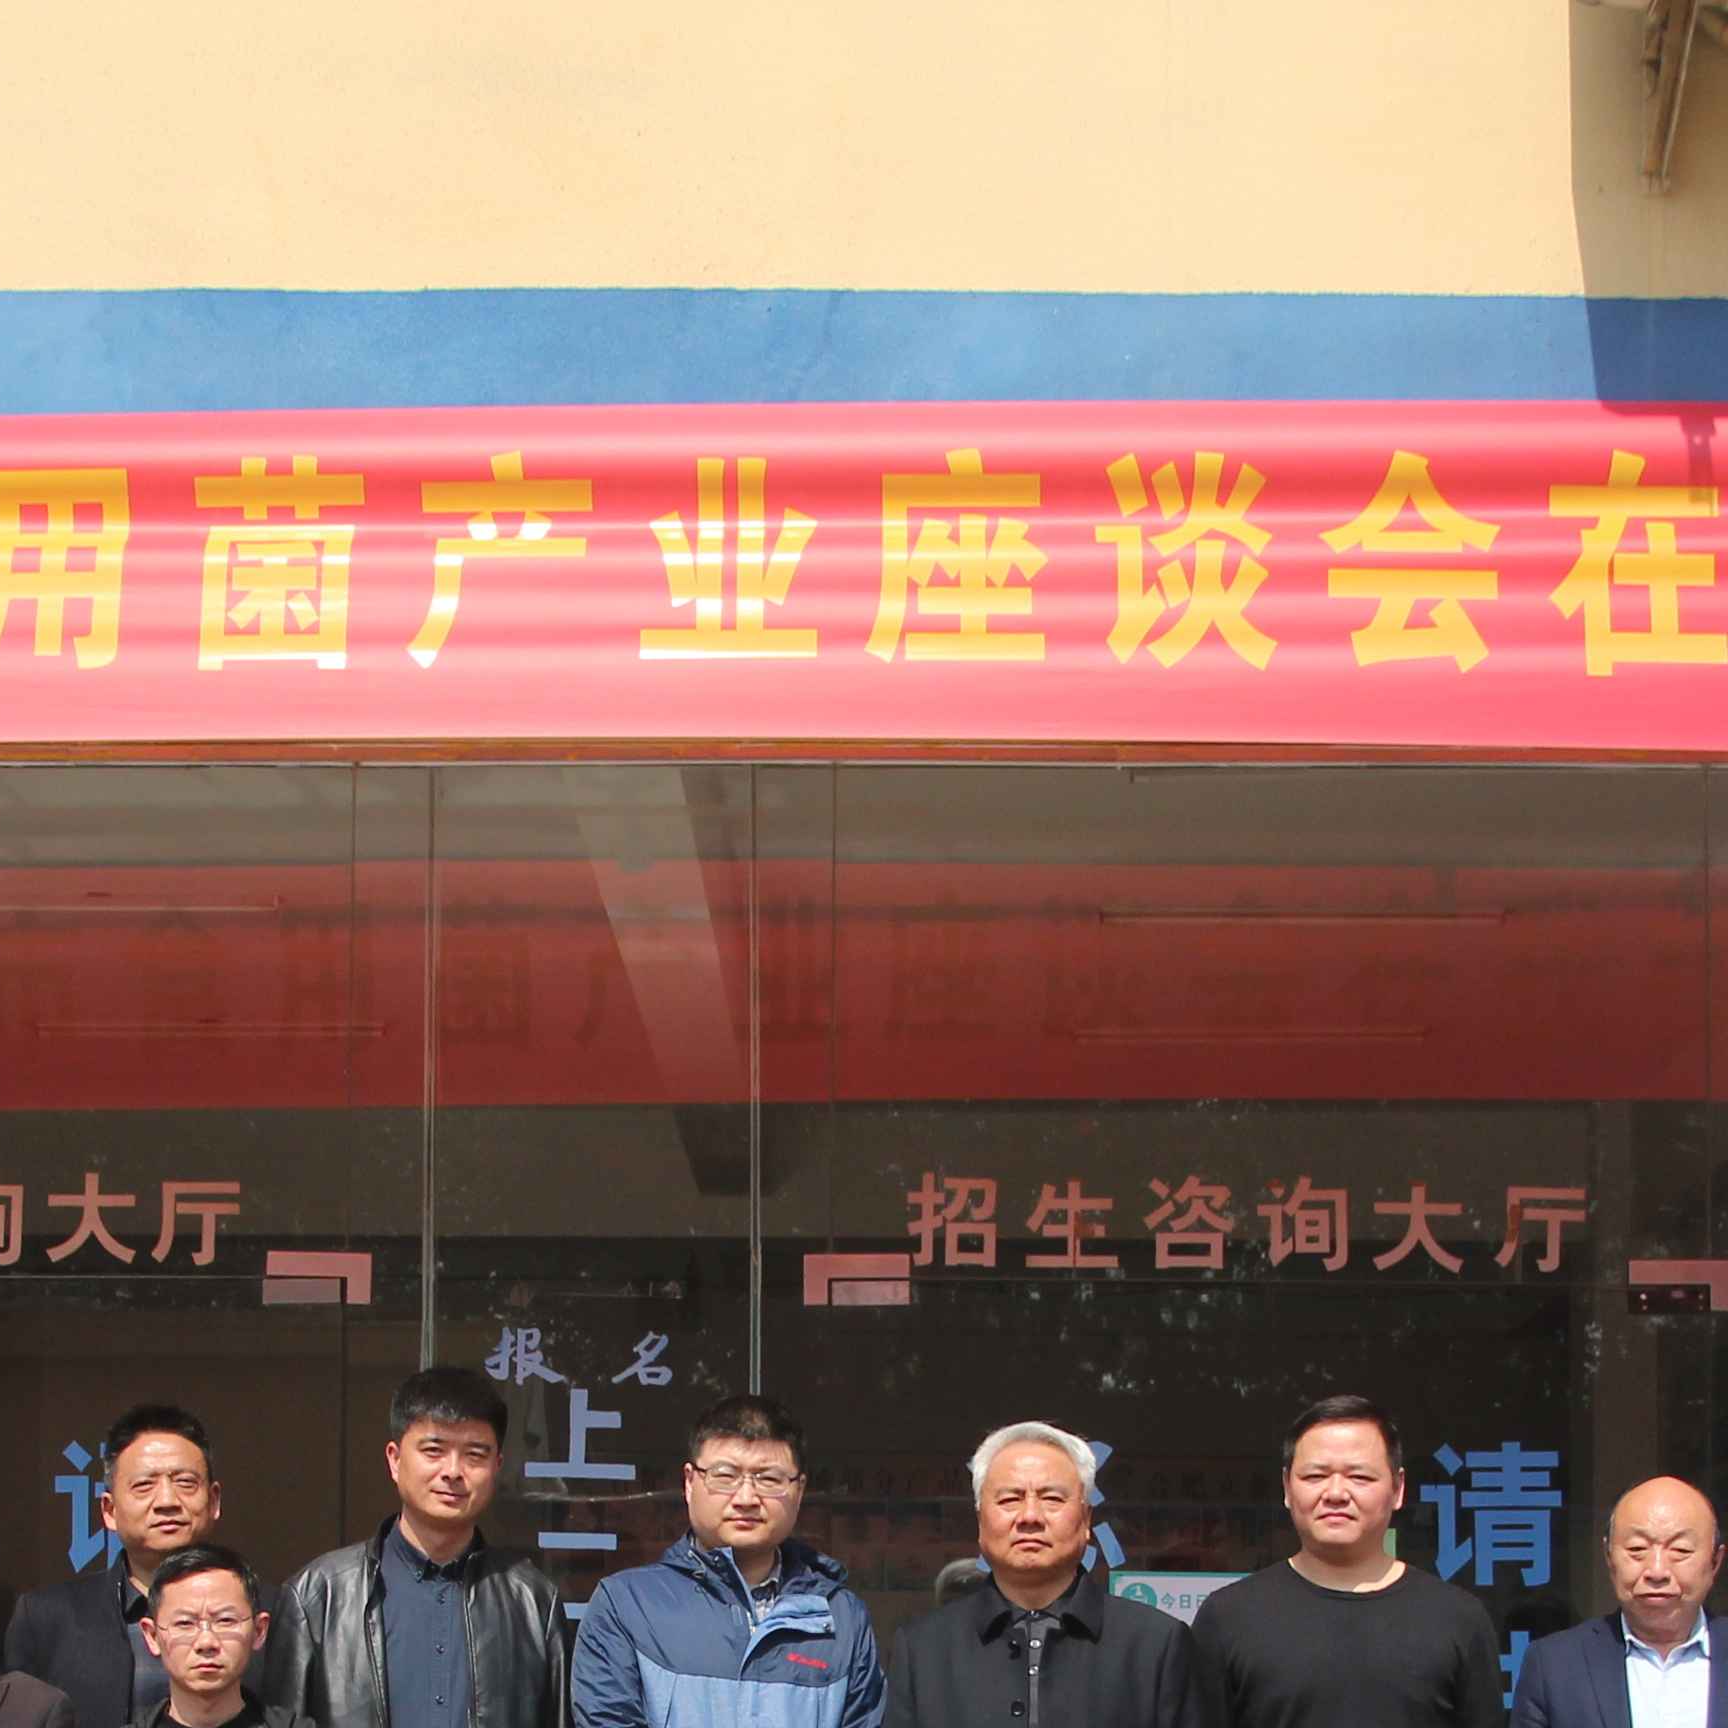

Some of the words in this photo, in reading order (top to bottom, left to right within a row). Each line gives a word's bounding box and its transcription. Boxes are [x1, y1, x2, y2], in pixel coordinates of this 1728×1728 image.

[906, 1172, 1587, 1274] 招生咨询大厅
[485, 1327, 673, 1386] 报名
